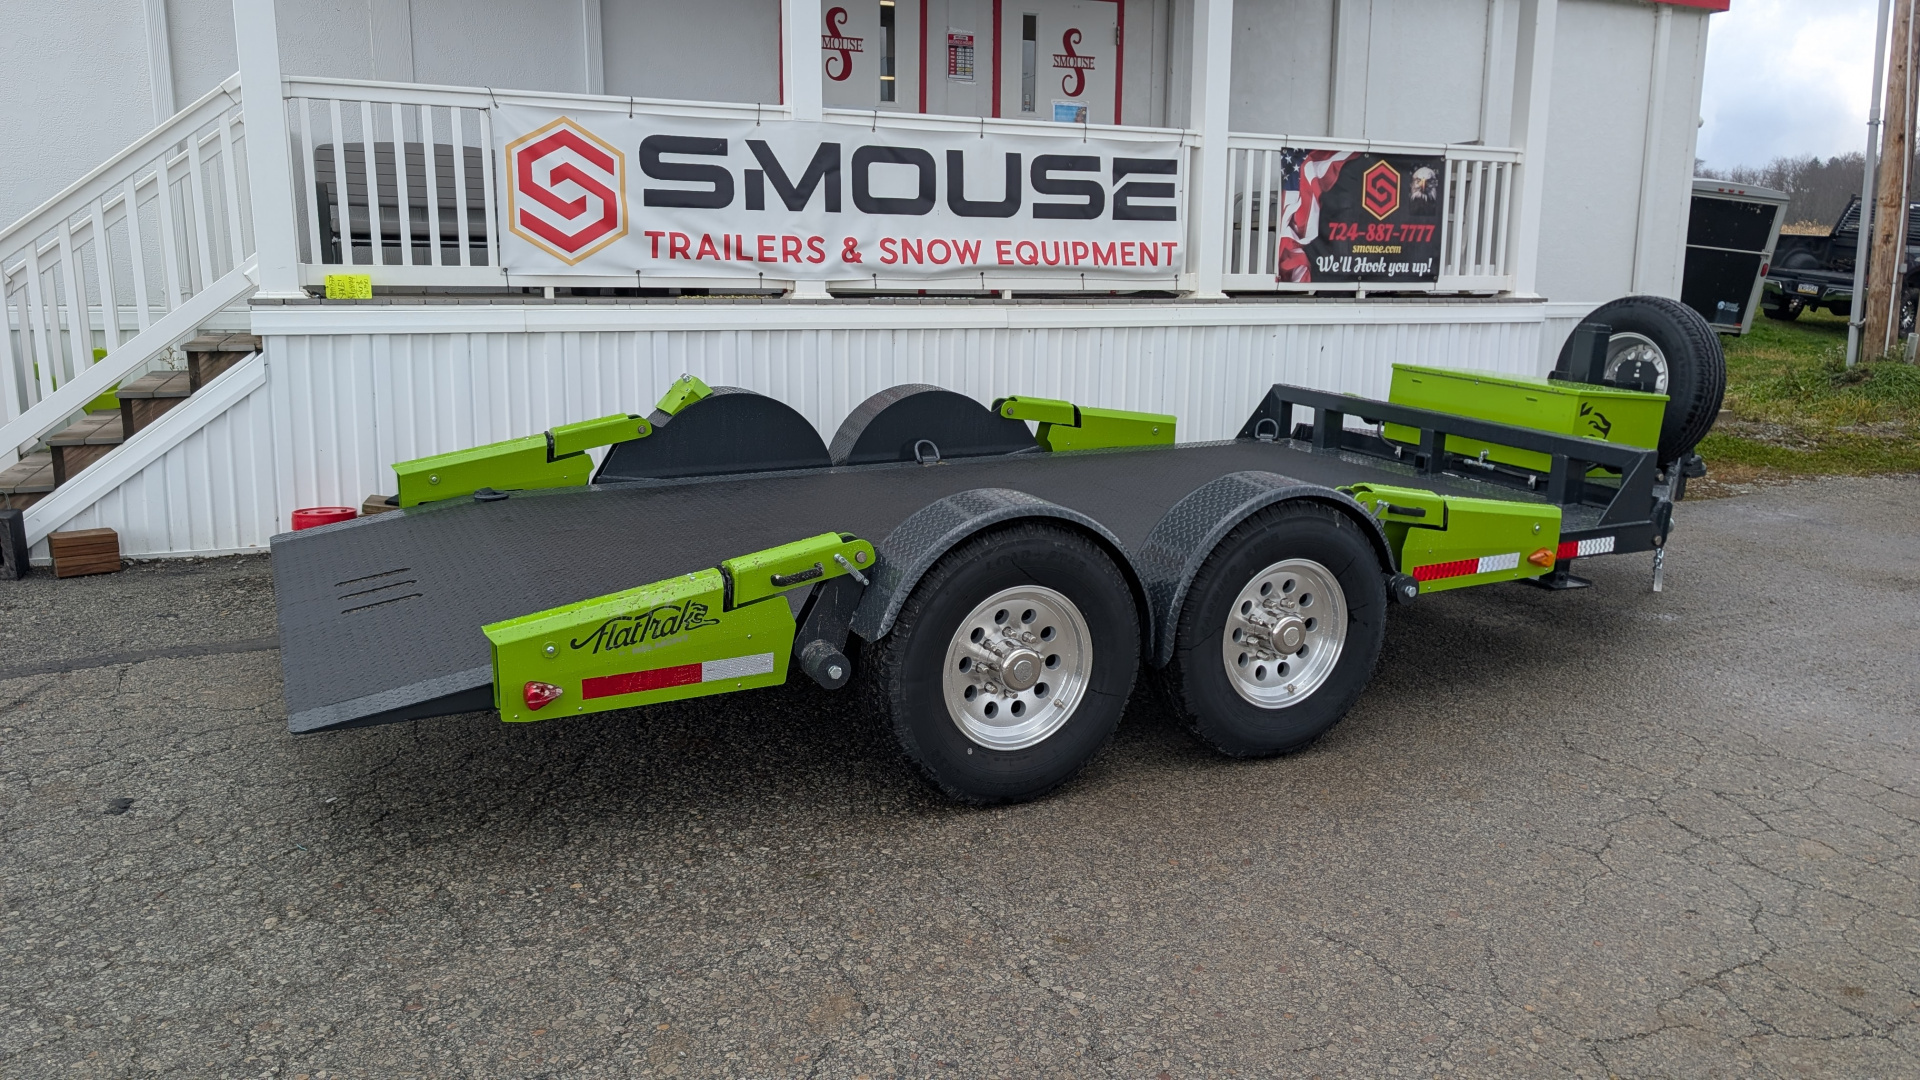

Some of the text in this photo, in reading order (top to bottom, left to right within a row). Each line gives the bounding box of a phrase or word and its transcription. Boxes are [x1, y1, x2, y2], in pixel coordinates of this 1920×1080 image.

[822, 37, 863, 51] MOUSE
[1053, 55, 1095, 69] SMOUSE
[639, 134, 1178, 221] SMOUSE
[1328, 222, 1435, 243] 724-887-7777
[644, 230, 1178, 266] TRAILERS & SNOW EQUIPMENT
[1352, 244, 1402, 254] smouse.com
[1316, 255, 1433, 277] We'll Hook you up!
